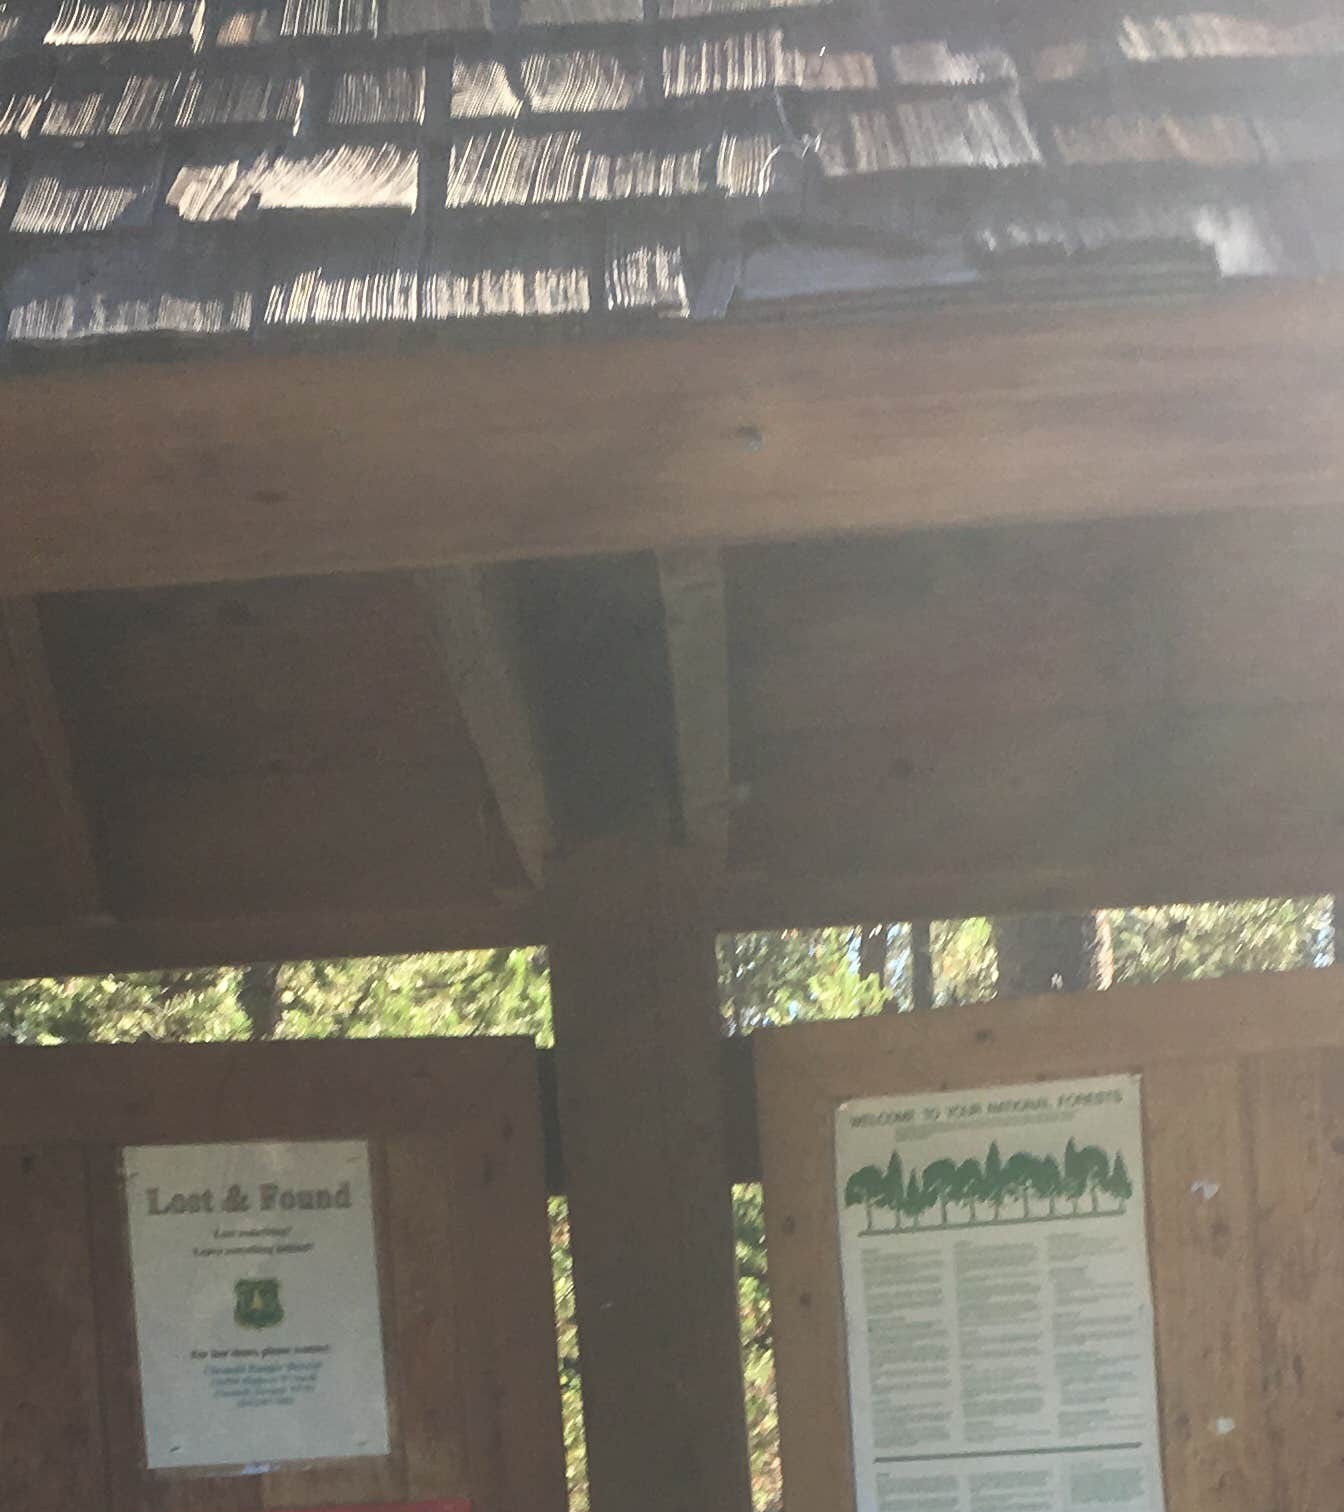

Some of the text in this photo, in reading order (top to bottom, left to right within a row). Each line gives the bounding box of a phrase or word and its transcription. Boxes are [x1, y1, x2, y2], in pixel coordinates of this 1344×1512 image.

[146, 1181, 353, 1216] Lost & Found
